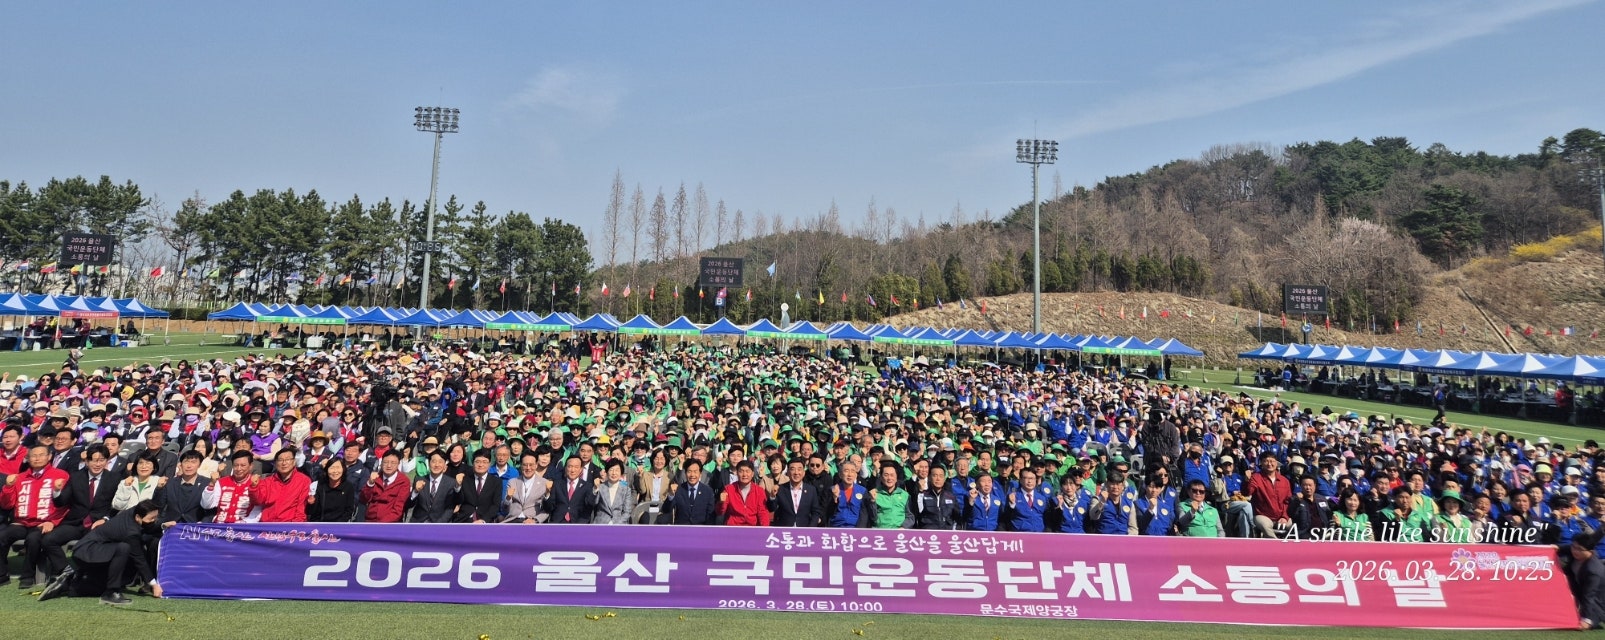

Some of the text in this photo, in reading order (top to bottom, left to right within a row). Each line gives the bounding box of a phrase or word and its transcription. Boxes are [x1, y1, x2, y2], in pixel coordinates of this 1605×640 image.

[17, 483, 31, 518] 시의원
[765, 531, 1025, 555] 소통과 화합으로 울산을 울산답게!
[302, 549, 1448, 608] 2026 울산 국민운동단체 소통의 날
[718, 599, 760, 609] 2026.
[840, 602, 883, 612] 10:00
[978, 603, 1079, 617] 문수국제양궁장
